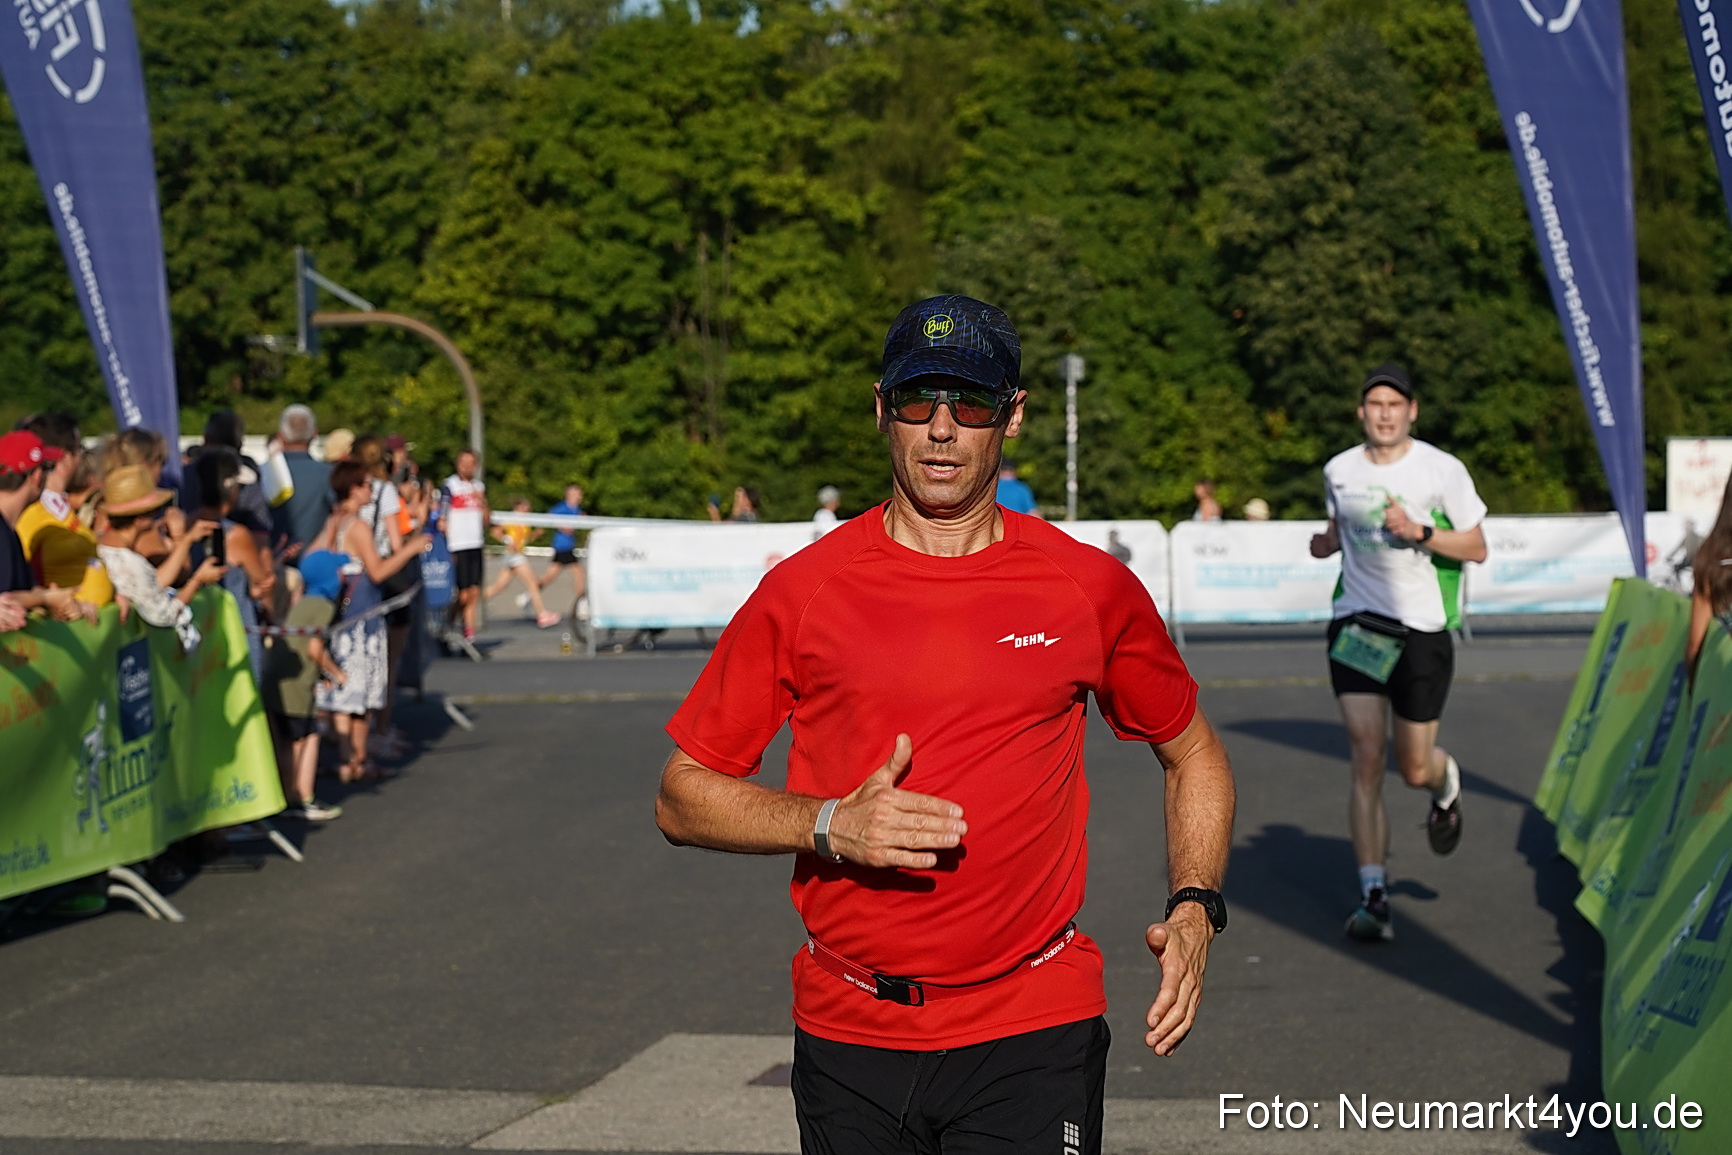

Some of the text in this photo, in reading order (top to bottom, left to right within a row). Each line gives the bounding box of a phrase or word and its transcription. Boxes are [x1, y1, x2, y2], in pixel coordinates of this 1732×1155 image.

[1014, 631, 1045, 648] DEHN
[1030, 941, 1065, 968] new balance
[843, 973, 857, 984] new
